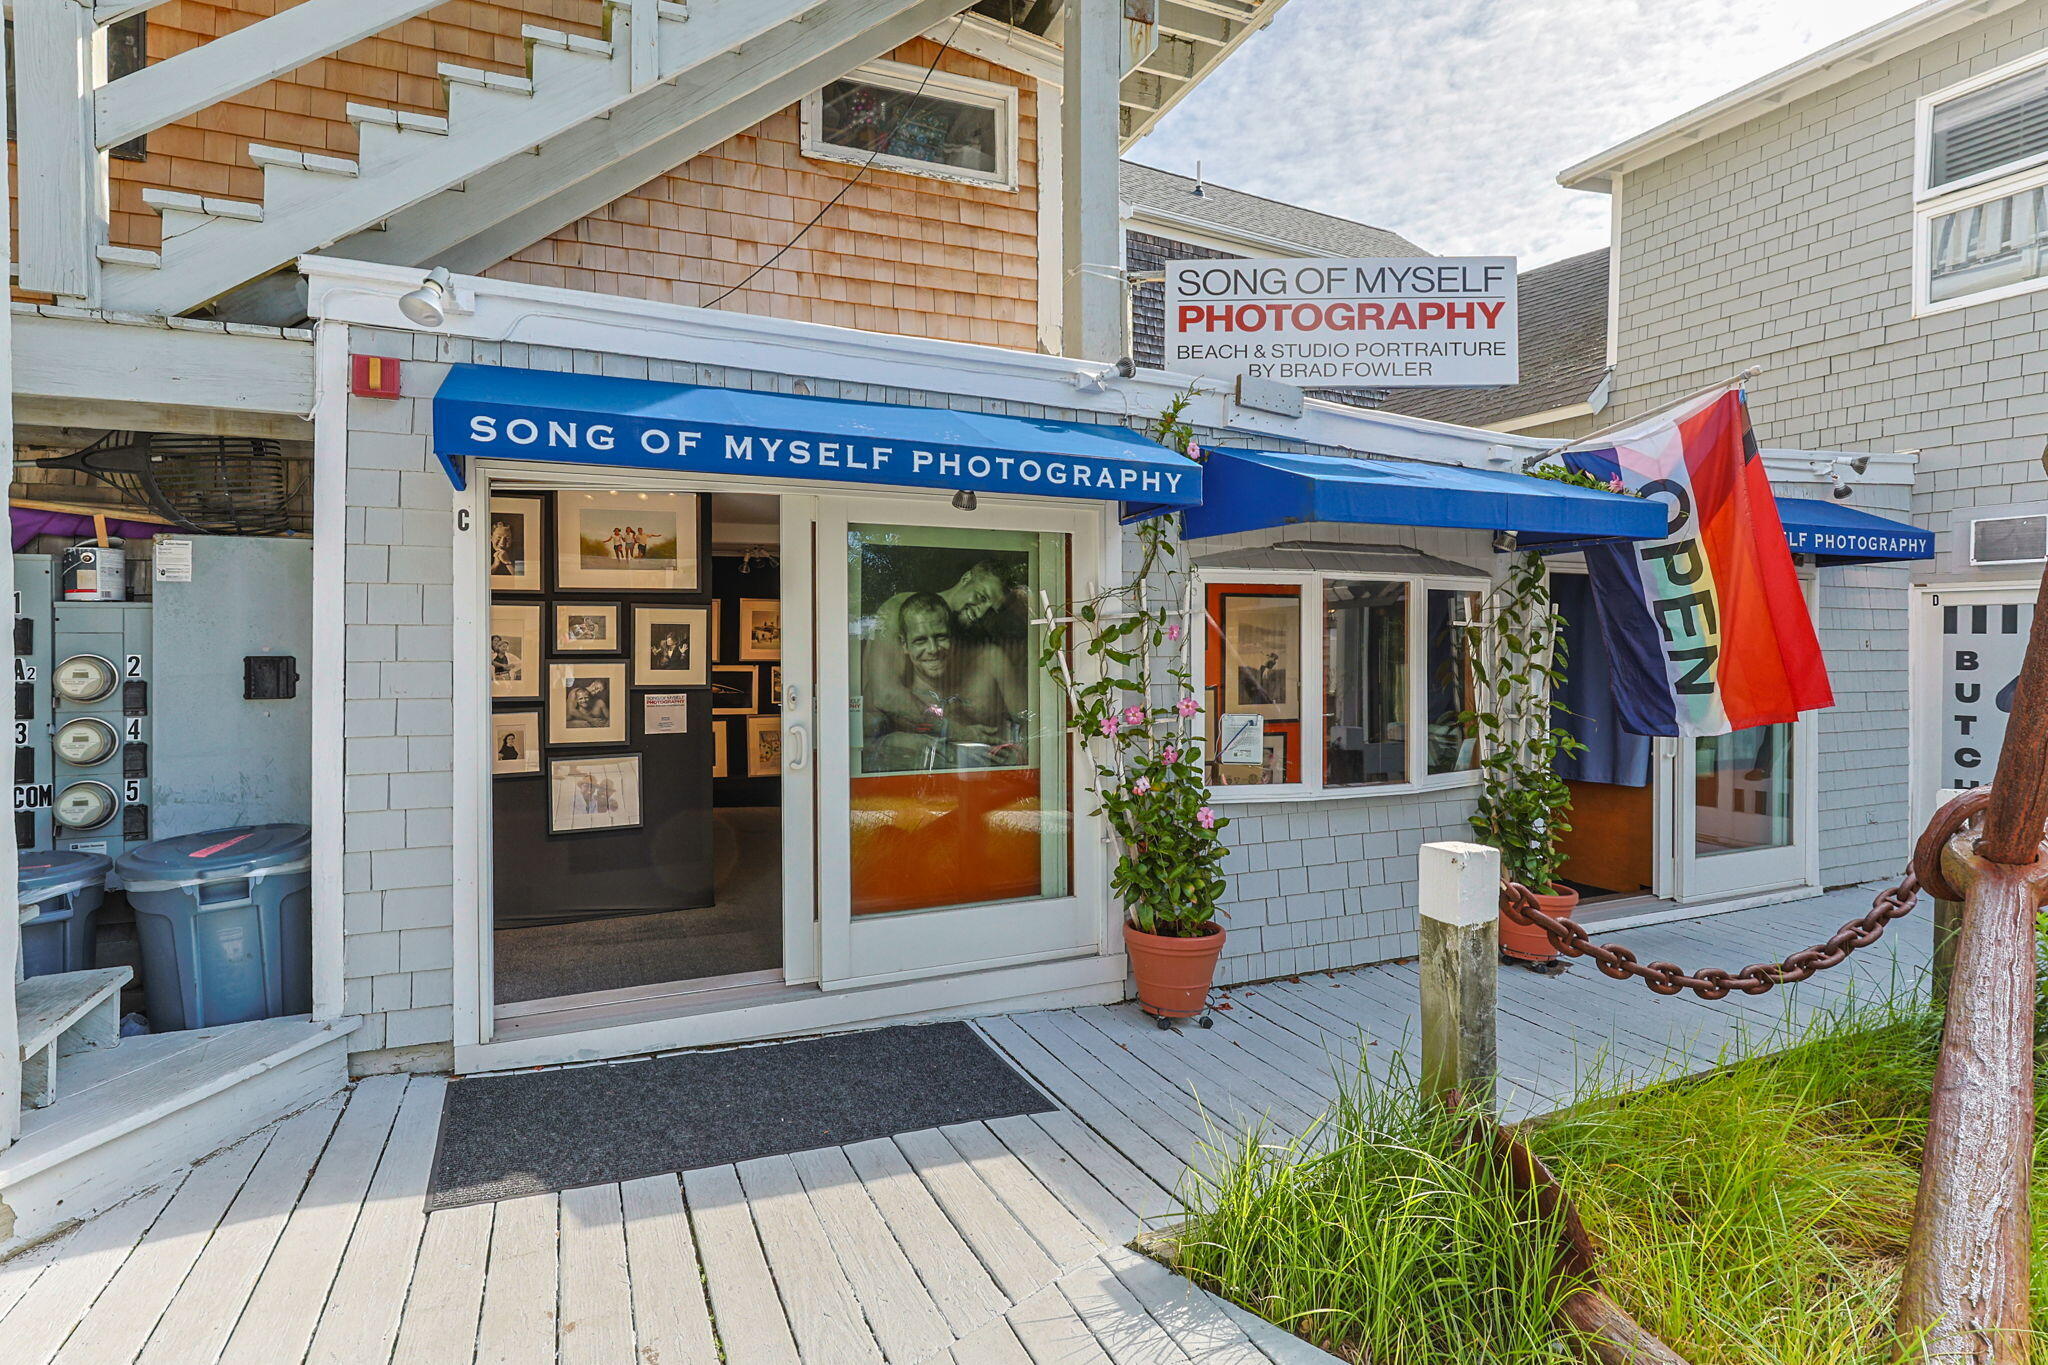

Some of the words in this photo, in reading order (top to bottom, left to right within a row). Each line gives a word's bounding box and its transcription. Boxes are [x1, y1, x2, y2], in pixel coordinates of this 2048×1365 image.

[1177, 267, 1287, 296] SONG
[1295, 267, 1348, 294] OF
[1356, 266, 1506, 294] MYSELF
[1178, 301, 1506, 333] PHOTOGRAPHY
[1177, 344, 1249, 360] BEACH
[1255, 344, 1267, 359] &
[1271, 343, 1350, 358] STUDIO
[1355, 341, 1507, 358] PORTRAITURE
[1249, 362, 1277, 378] BY
[1280, 362, 1338, 378] BRAD
[1342, 361, 1432, 378] FOWLER
[470, 415, 616, 451] SONG
[640, 429, 702, 456] OF
[725, 434, 893, 470] MYSELF
[912, 449, 1183, 494] PHOTOGRAPHY
[457, 508, 470, 532] C
[1784, 531, 1808, 547] LF
[1814, 533, 1927, 553] PHOTOGRAPHY
[1640, 478, 1720, 696] OPEN
[1932, 594, 1939, 606] D
[127, 655, 140, 677] 2
[15, 722, 27, 744] 3
[128, 719, 140, 740] 4
[14, 785, 52, 808] COM
[126, 780, 139, 801] 5
